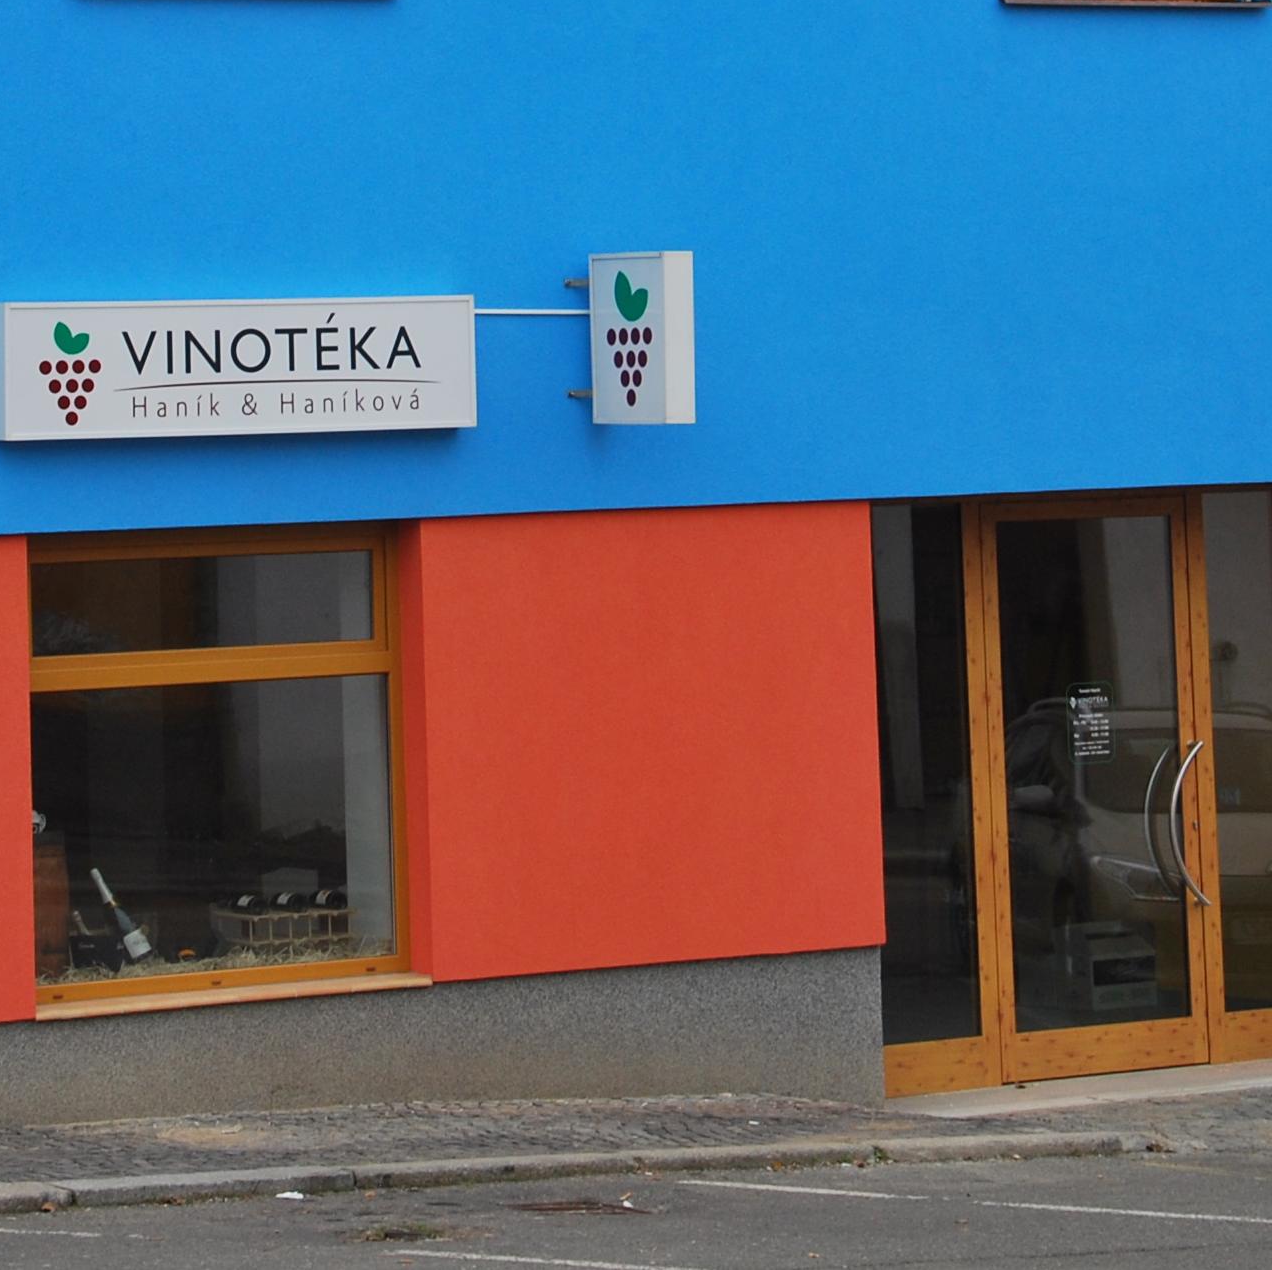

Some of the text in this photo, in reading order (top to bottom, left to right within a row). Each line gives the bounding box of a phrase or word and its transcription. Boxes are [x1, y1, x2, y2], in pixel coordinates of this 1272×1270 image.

[121, 312, 422, 376] VINOTÉKA
[131, 388, 420, 418] Haník & Haníková
